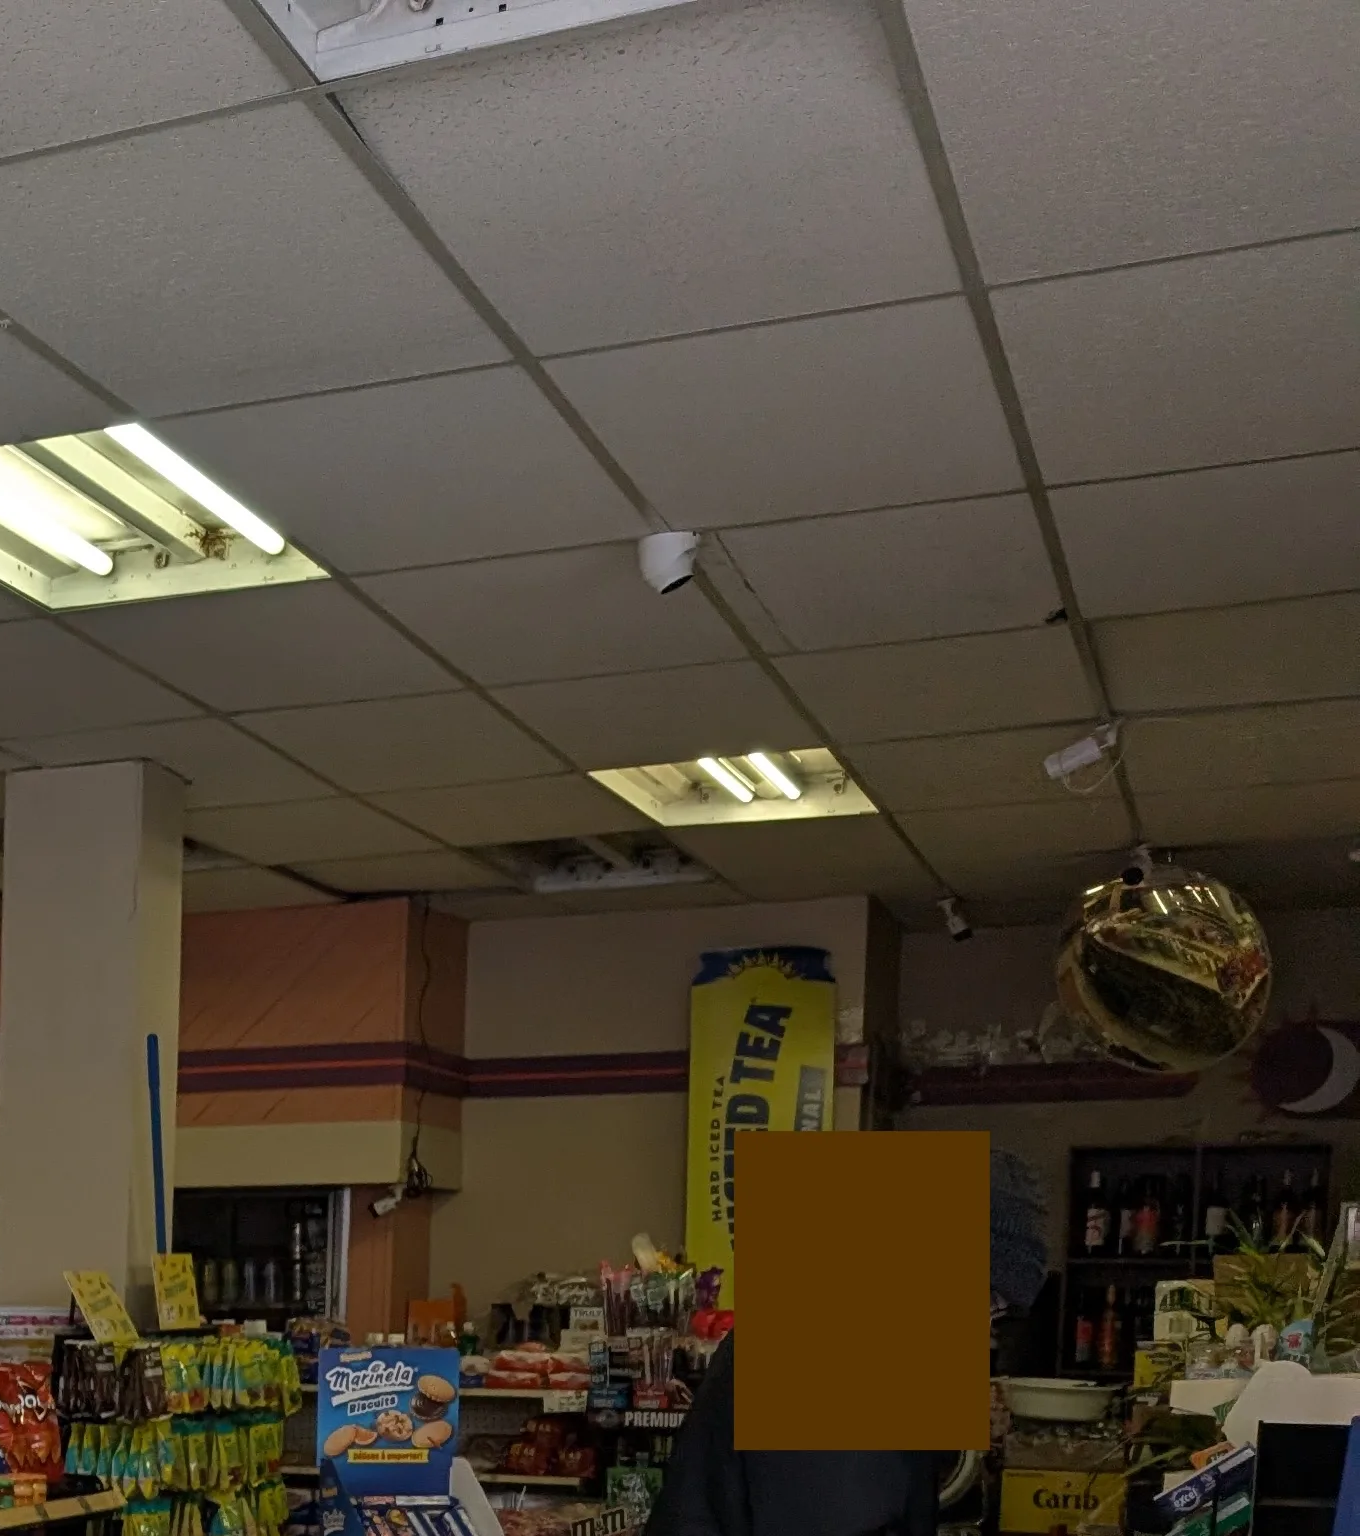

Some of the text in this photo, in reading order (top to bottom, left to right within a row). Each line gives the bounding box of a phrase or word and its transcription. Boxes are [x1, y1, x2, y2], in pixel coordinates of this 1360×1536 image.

[730, 1003, 794, 1084] TEA
[710, 1075, 726, 1223] HARD ICED TEA
[326, 1360, 413, 1391] Marinela
[349, 1396, 396, 1414] Biscuits
[1032, 1487, 1102, 1512] Carib
[1173, 1490, 1198, 1511] excel
